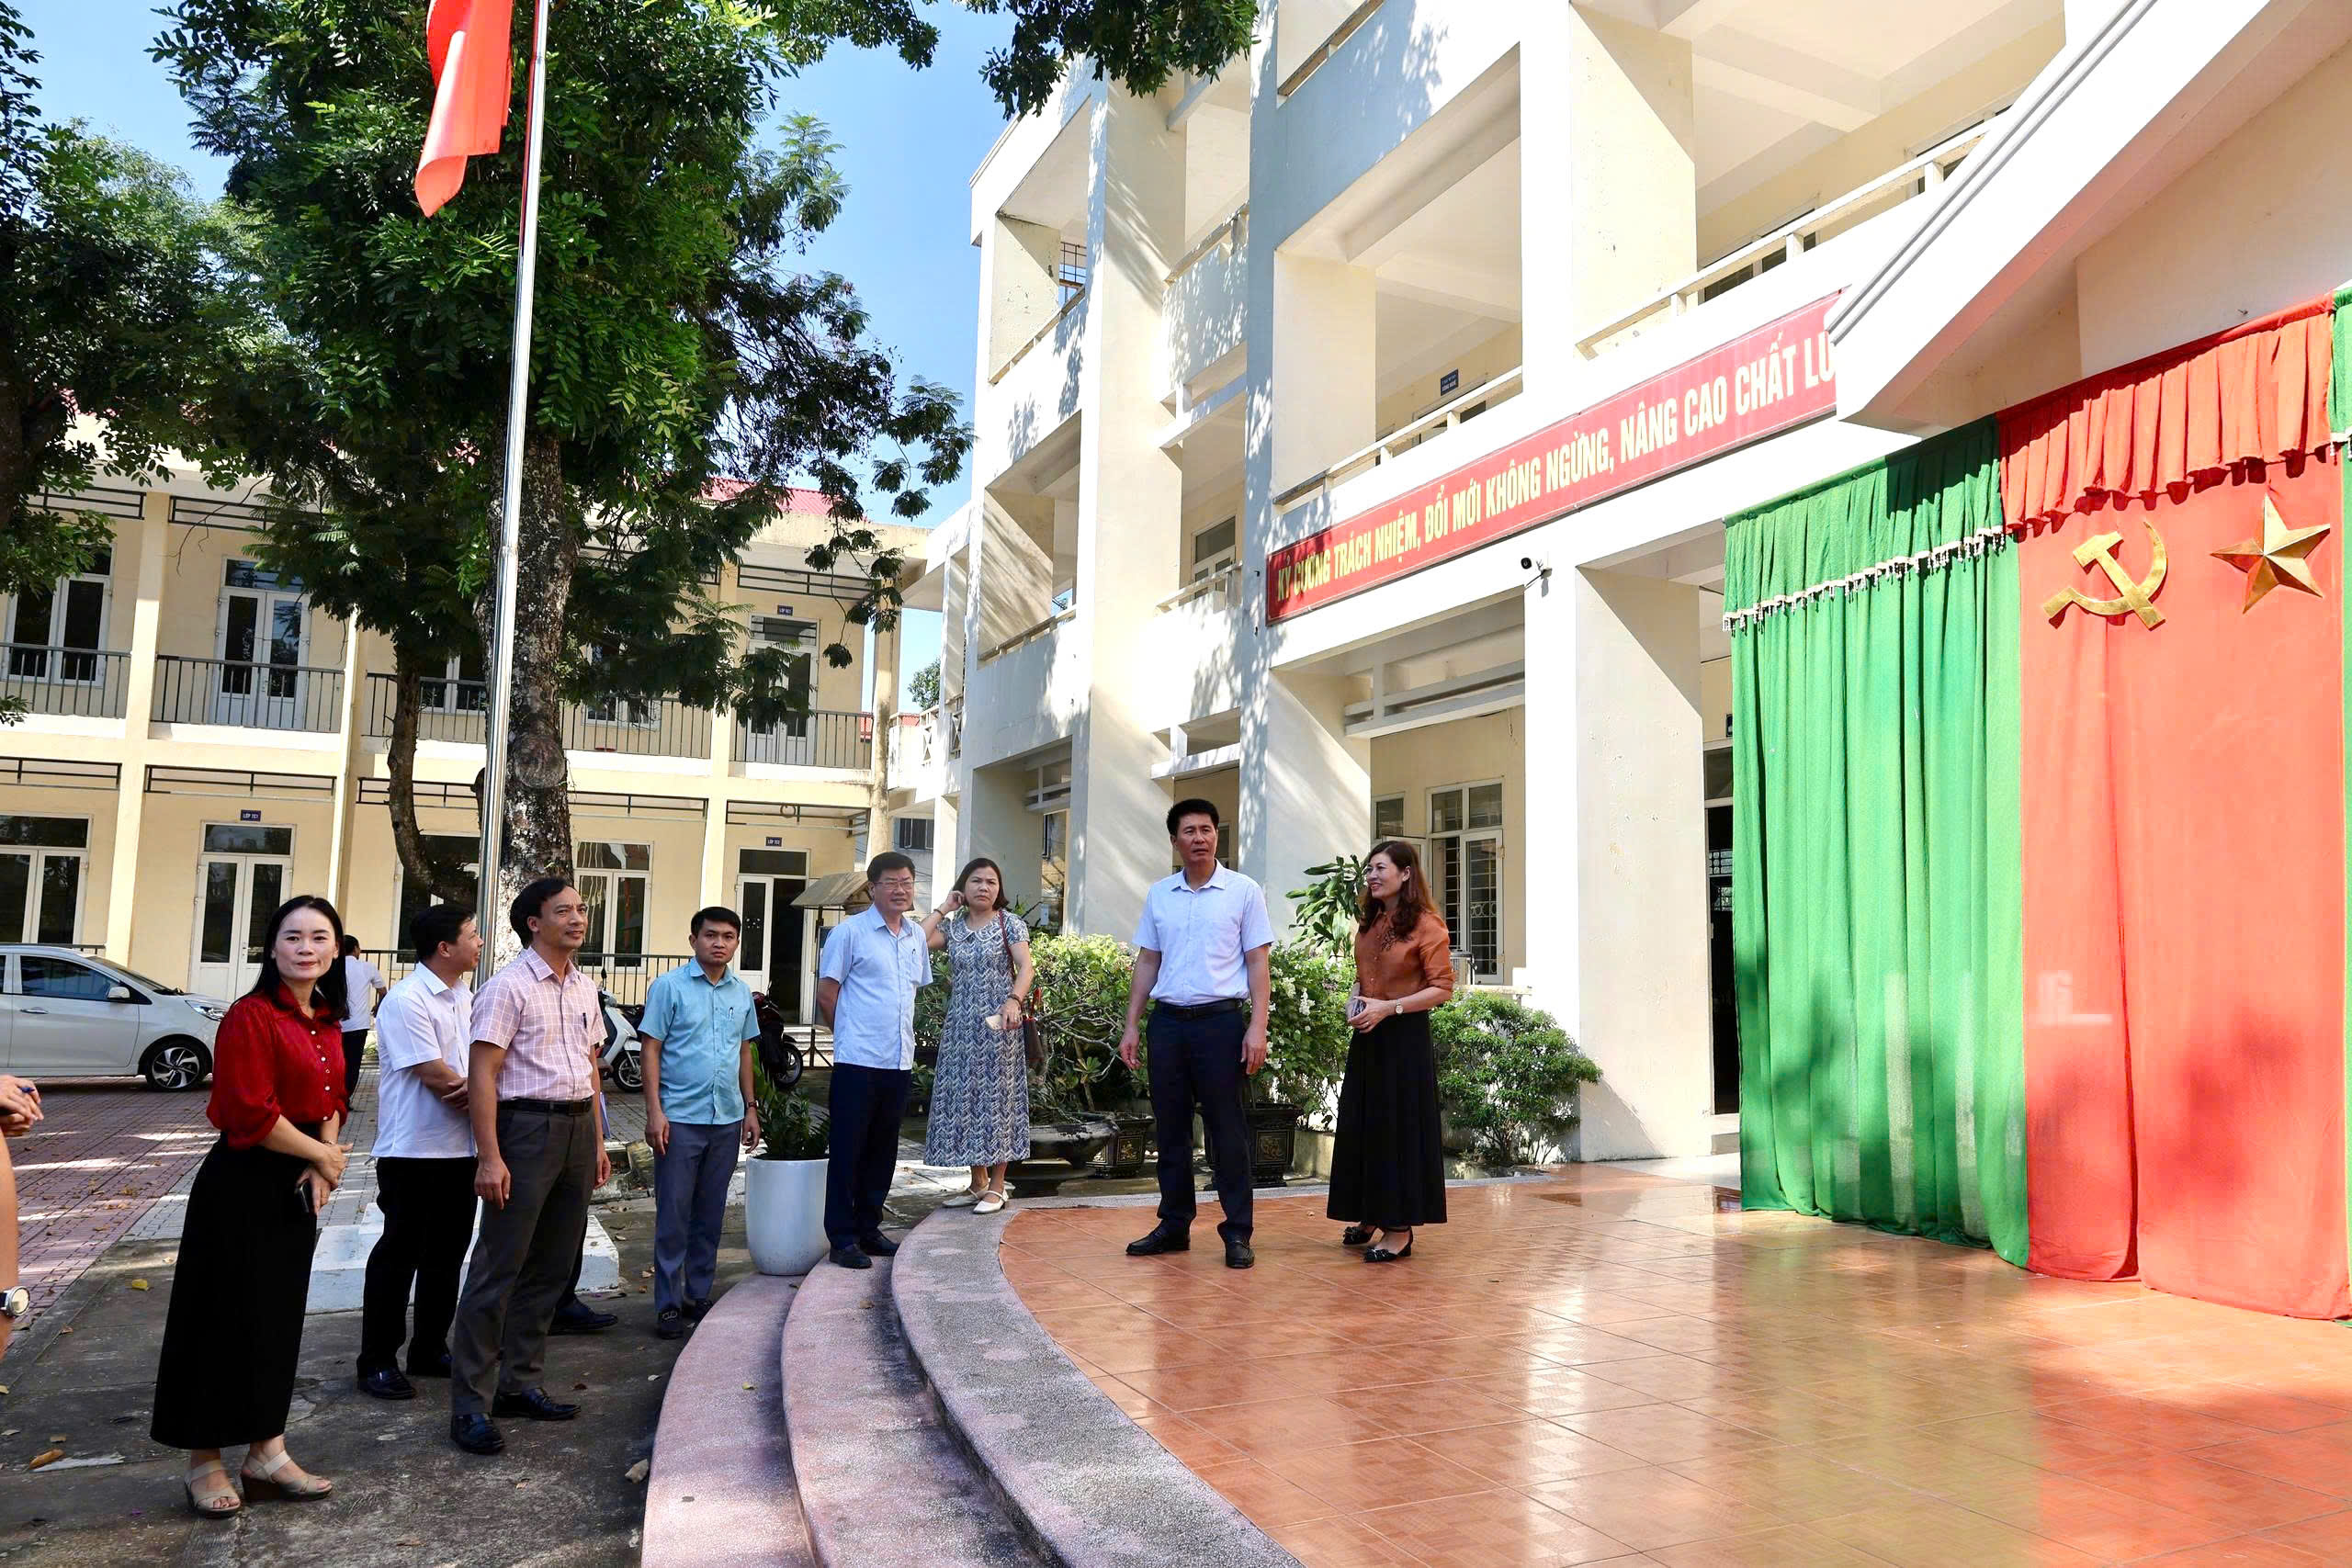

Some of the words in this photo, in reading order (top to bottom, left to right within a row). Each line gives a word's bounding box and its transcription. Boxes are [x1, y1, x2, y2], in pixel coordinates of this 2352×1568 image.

[1333, 530, 1372, 580] TRÁCH
[1374, 509, 1421, 563] NHIỆM,
[1425, 484, 1449, 544] ĐỔI
[1453, 478, 1481, 533] MỚI
[1486, 457, 1541, 519] KHÔNG
[1546, 427, 1614, 493] NGỪNG,
[1621, 400, 1678, 464] NÂNG
[1684, 376, 1728, 437] CAO
[1736, 330, 1797, 416] CHẤT
